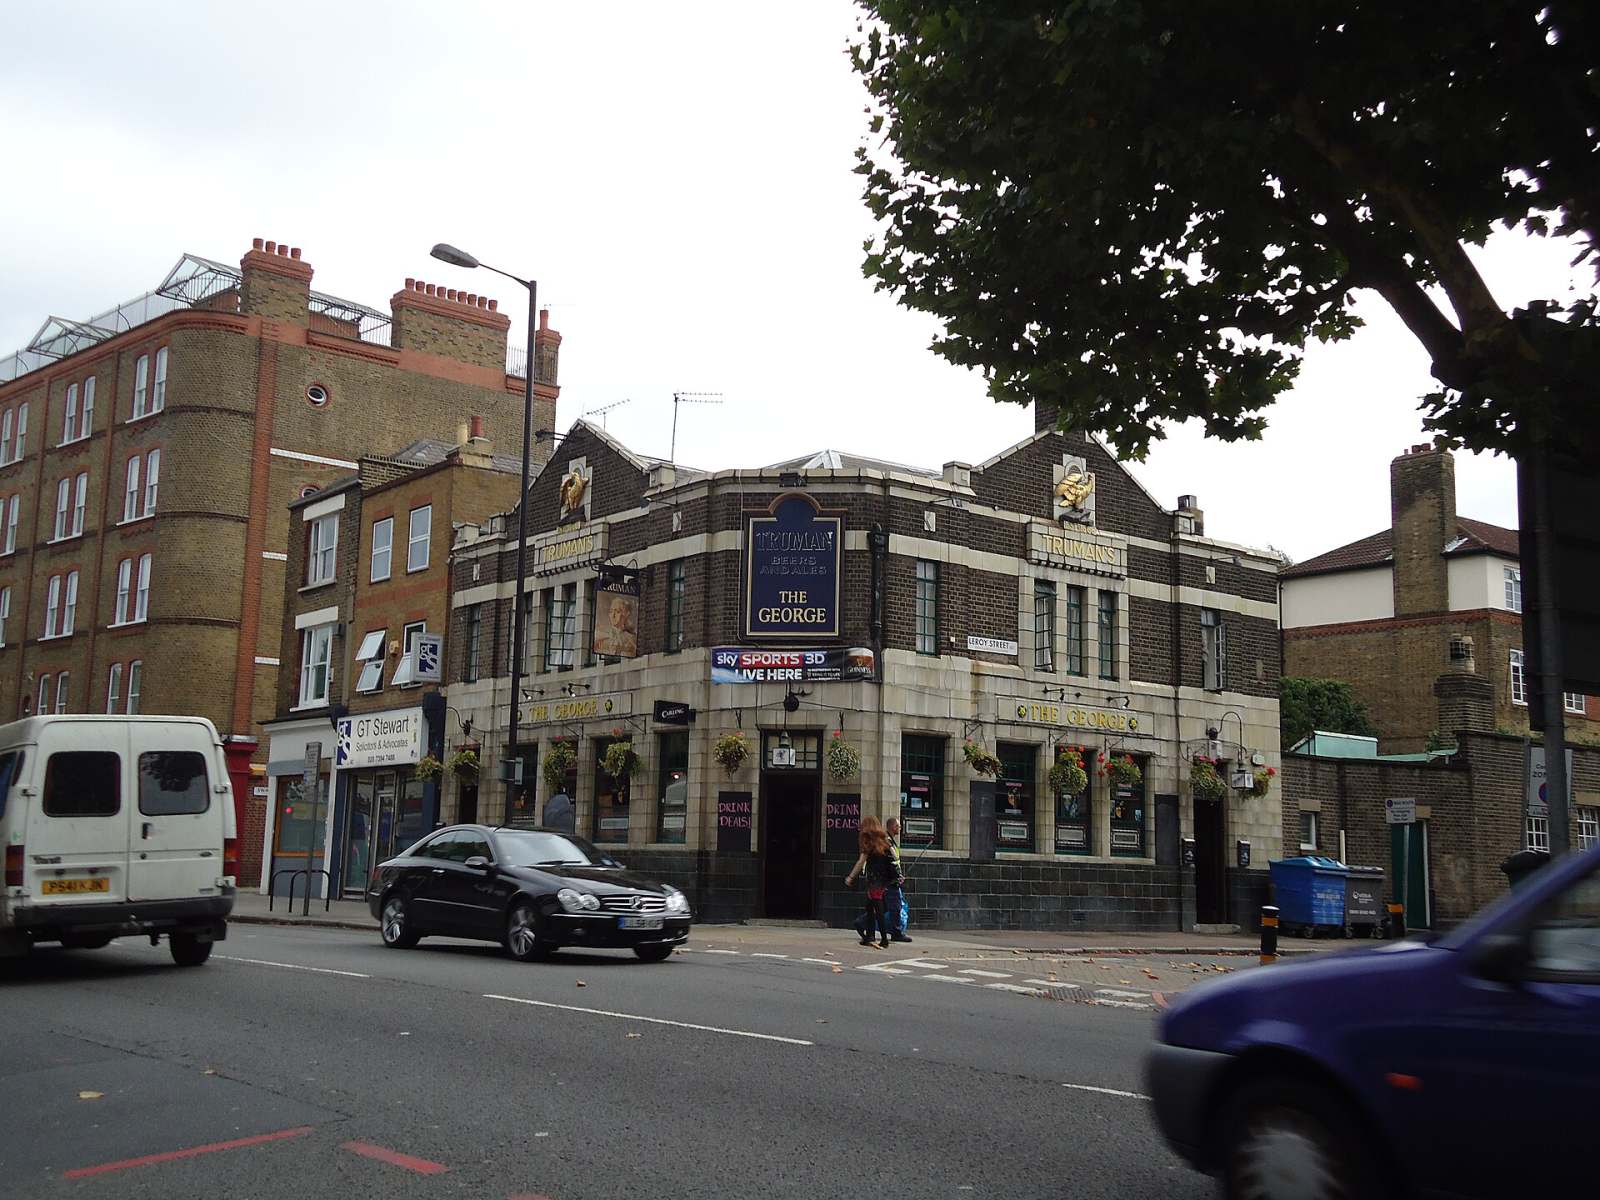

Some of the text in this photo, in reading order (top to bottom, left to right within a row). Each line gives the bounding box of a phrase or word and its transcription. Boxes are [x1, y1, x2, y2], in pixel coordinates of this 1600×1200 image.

[542, 535, 594, 563] TRUMAN'S
[755, 531, 834, 552] TRUMAN
[1043, 534, 1116, 566] TRUMAN'S
[770, 556, 818, 566] BEERS
[778, 590, 808, 604] THE
[758, 607, 827, 624] GEORGE
[968, 637, 987, 647] LEROY
[988, 639, 1010, 650] STREET
[716, 652, 826, 668] sky SPORTS 3D
[735, 668, 803, 681] LIVE HERE
[529, 697, 598, 722] THE GEORGE
[1030, 703, 1127, 731] THE GEORGE
[357, 715, 409, 738] GT Stewart
[356, 741, 377, 753] Solicitors
[718, 802, 751, 814] DRINK
[826, 803, 860, 816] DRINK
[720, 815, 752, 829] DEALS!
